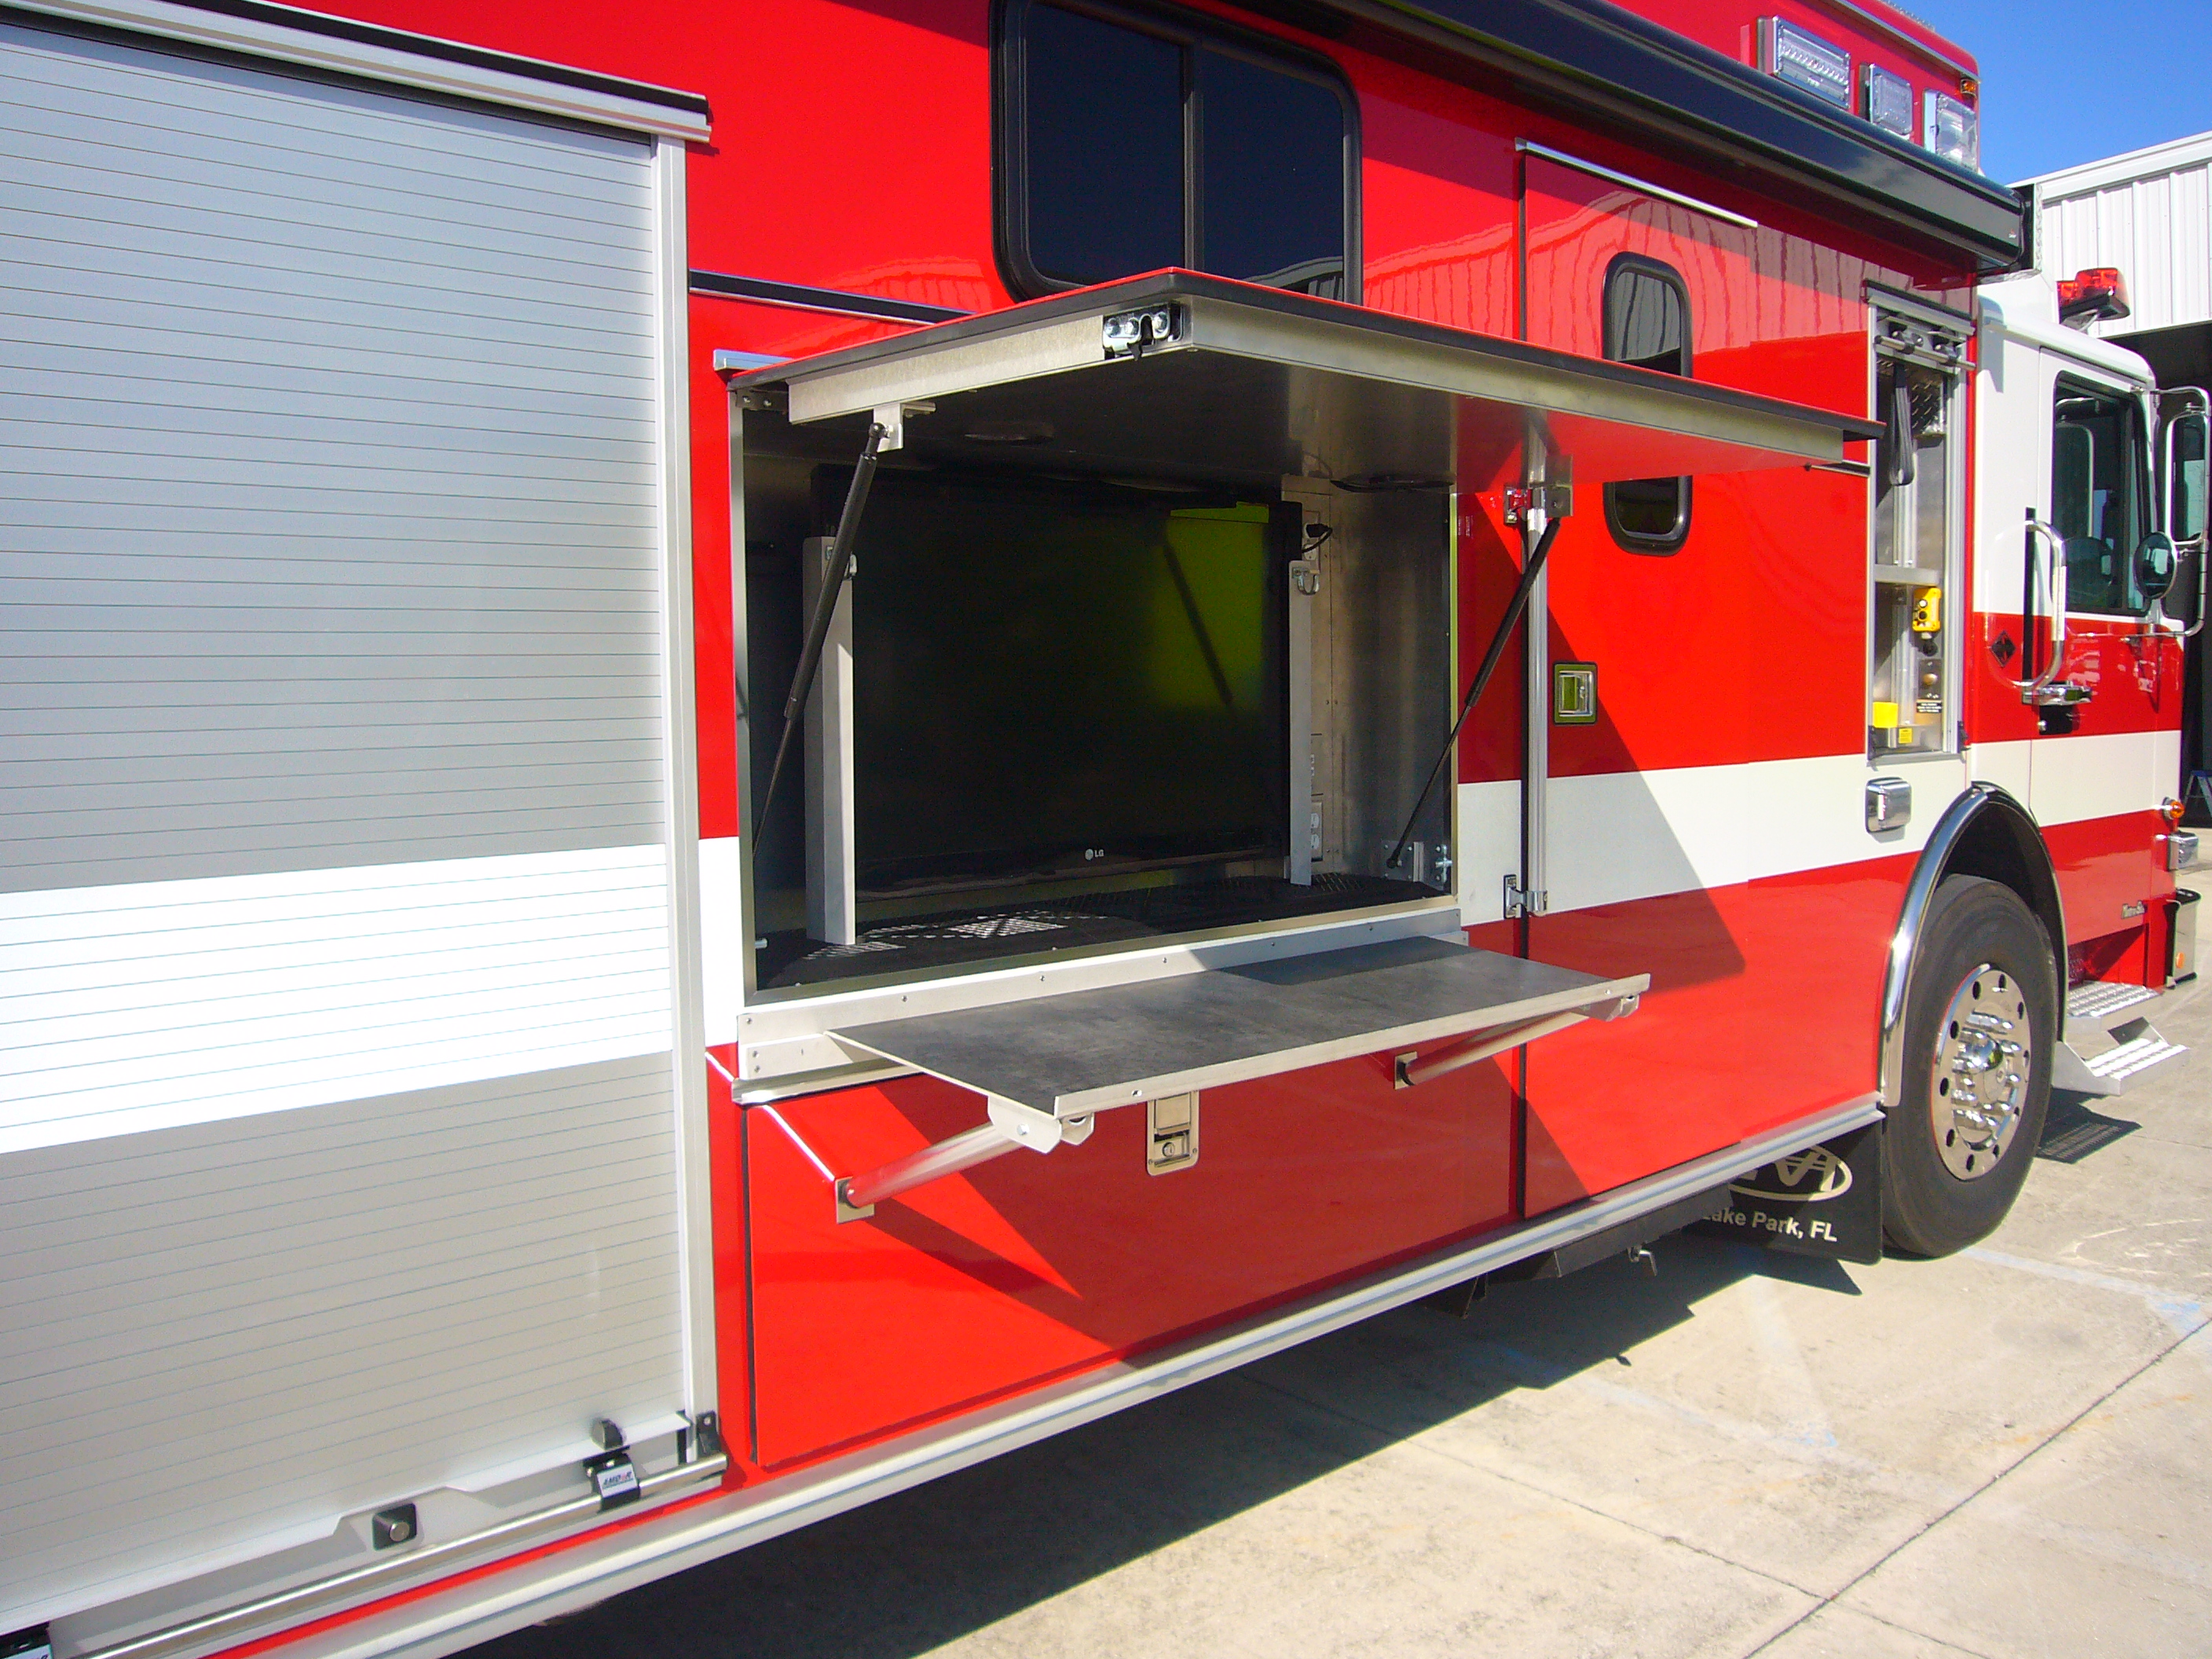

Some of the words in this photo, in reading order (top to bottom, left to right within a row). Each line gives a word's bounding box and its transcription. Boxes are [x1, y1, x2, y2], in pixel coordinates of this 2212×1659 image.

[1702, 1207, 1746, 1226] ake
[1752, 1210, 1804, 1240] Park,
[1810, 1220, 1837, 1242] FL
